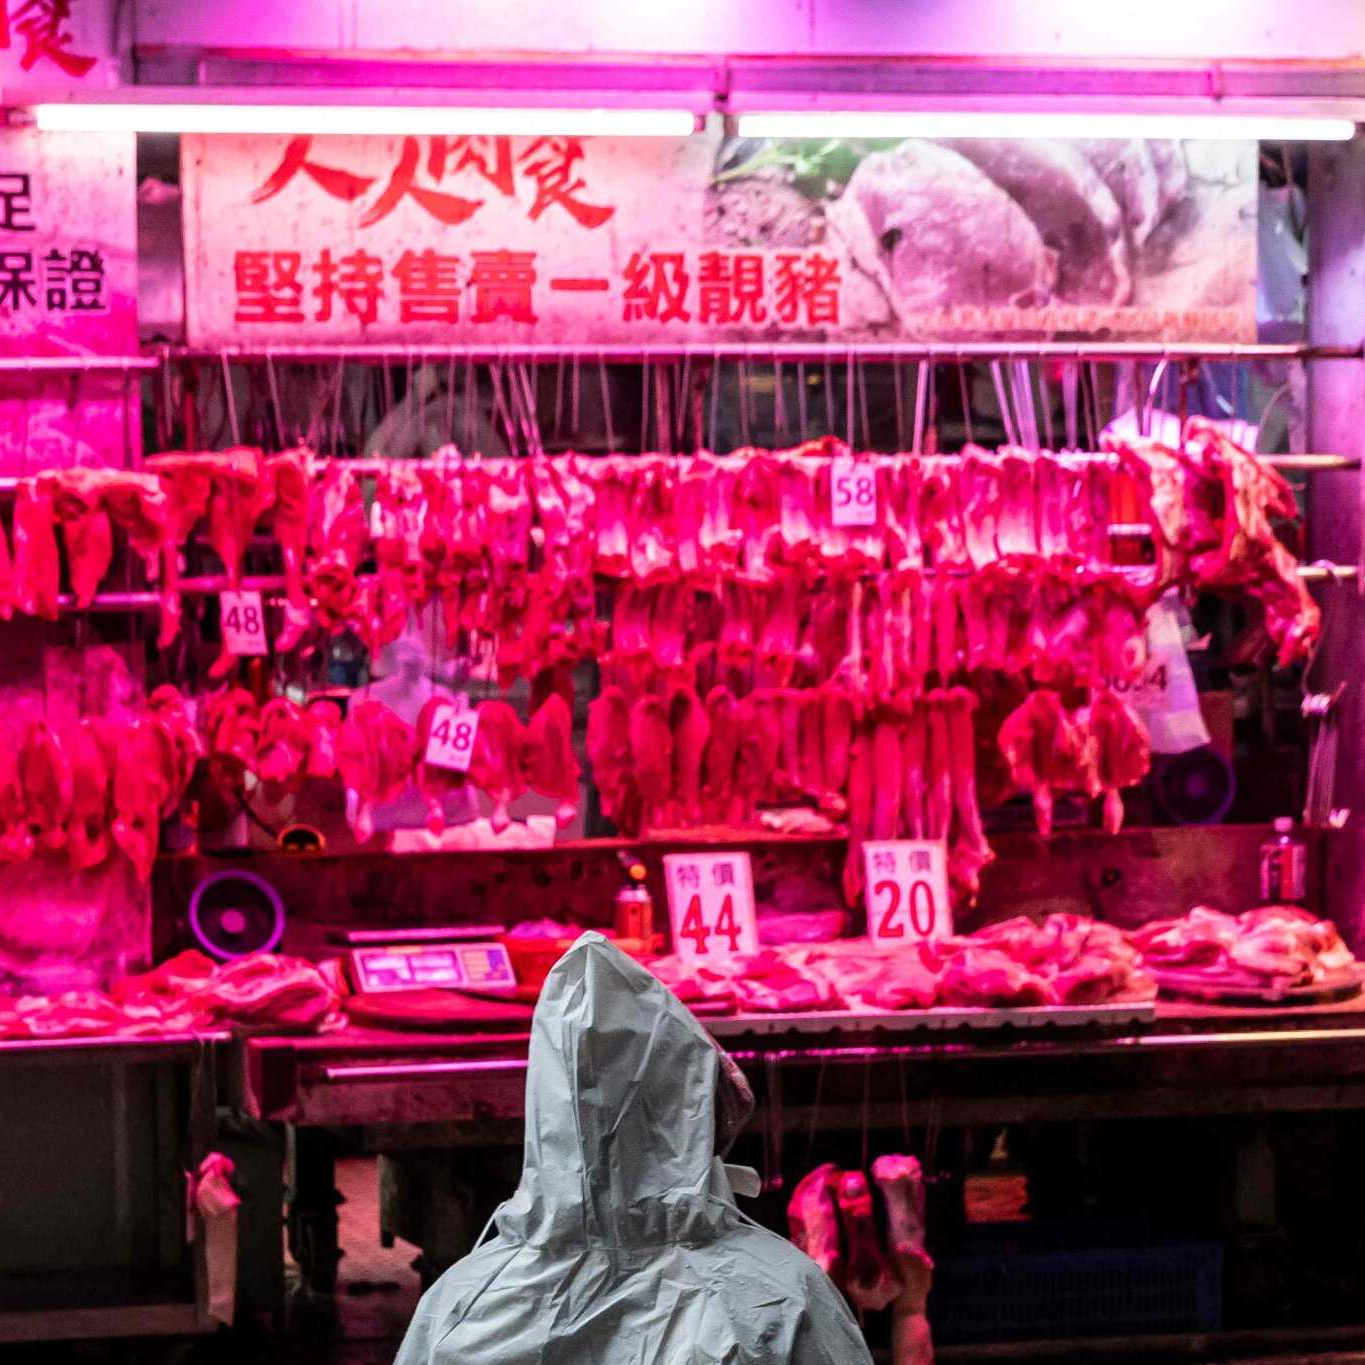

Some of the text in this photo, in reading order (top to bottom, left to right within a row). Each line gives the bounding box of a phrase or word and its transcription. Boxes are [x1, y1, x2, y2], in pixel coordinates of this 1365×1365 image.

[233, 248, 842, 326] 堅持售賣一級靚豬
[837, 477, 873, 507] 58
[227, 606, 260, 635] 48
[433, 719, 472, 752] 48
[680, 893, 742, 955] 44
[874, 879, 936, 938] 20
